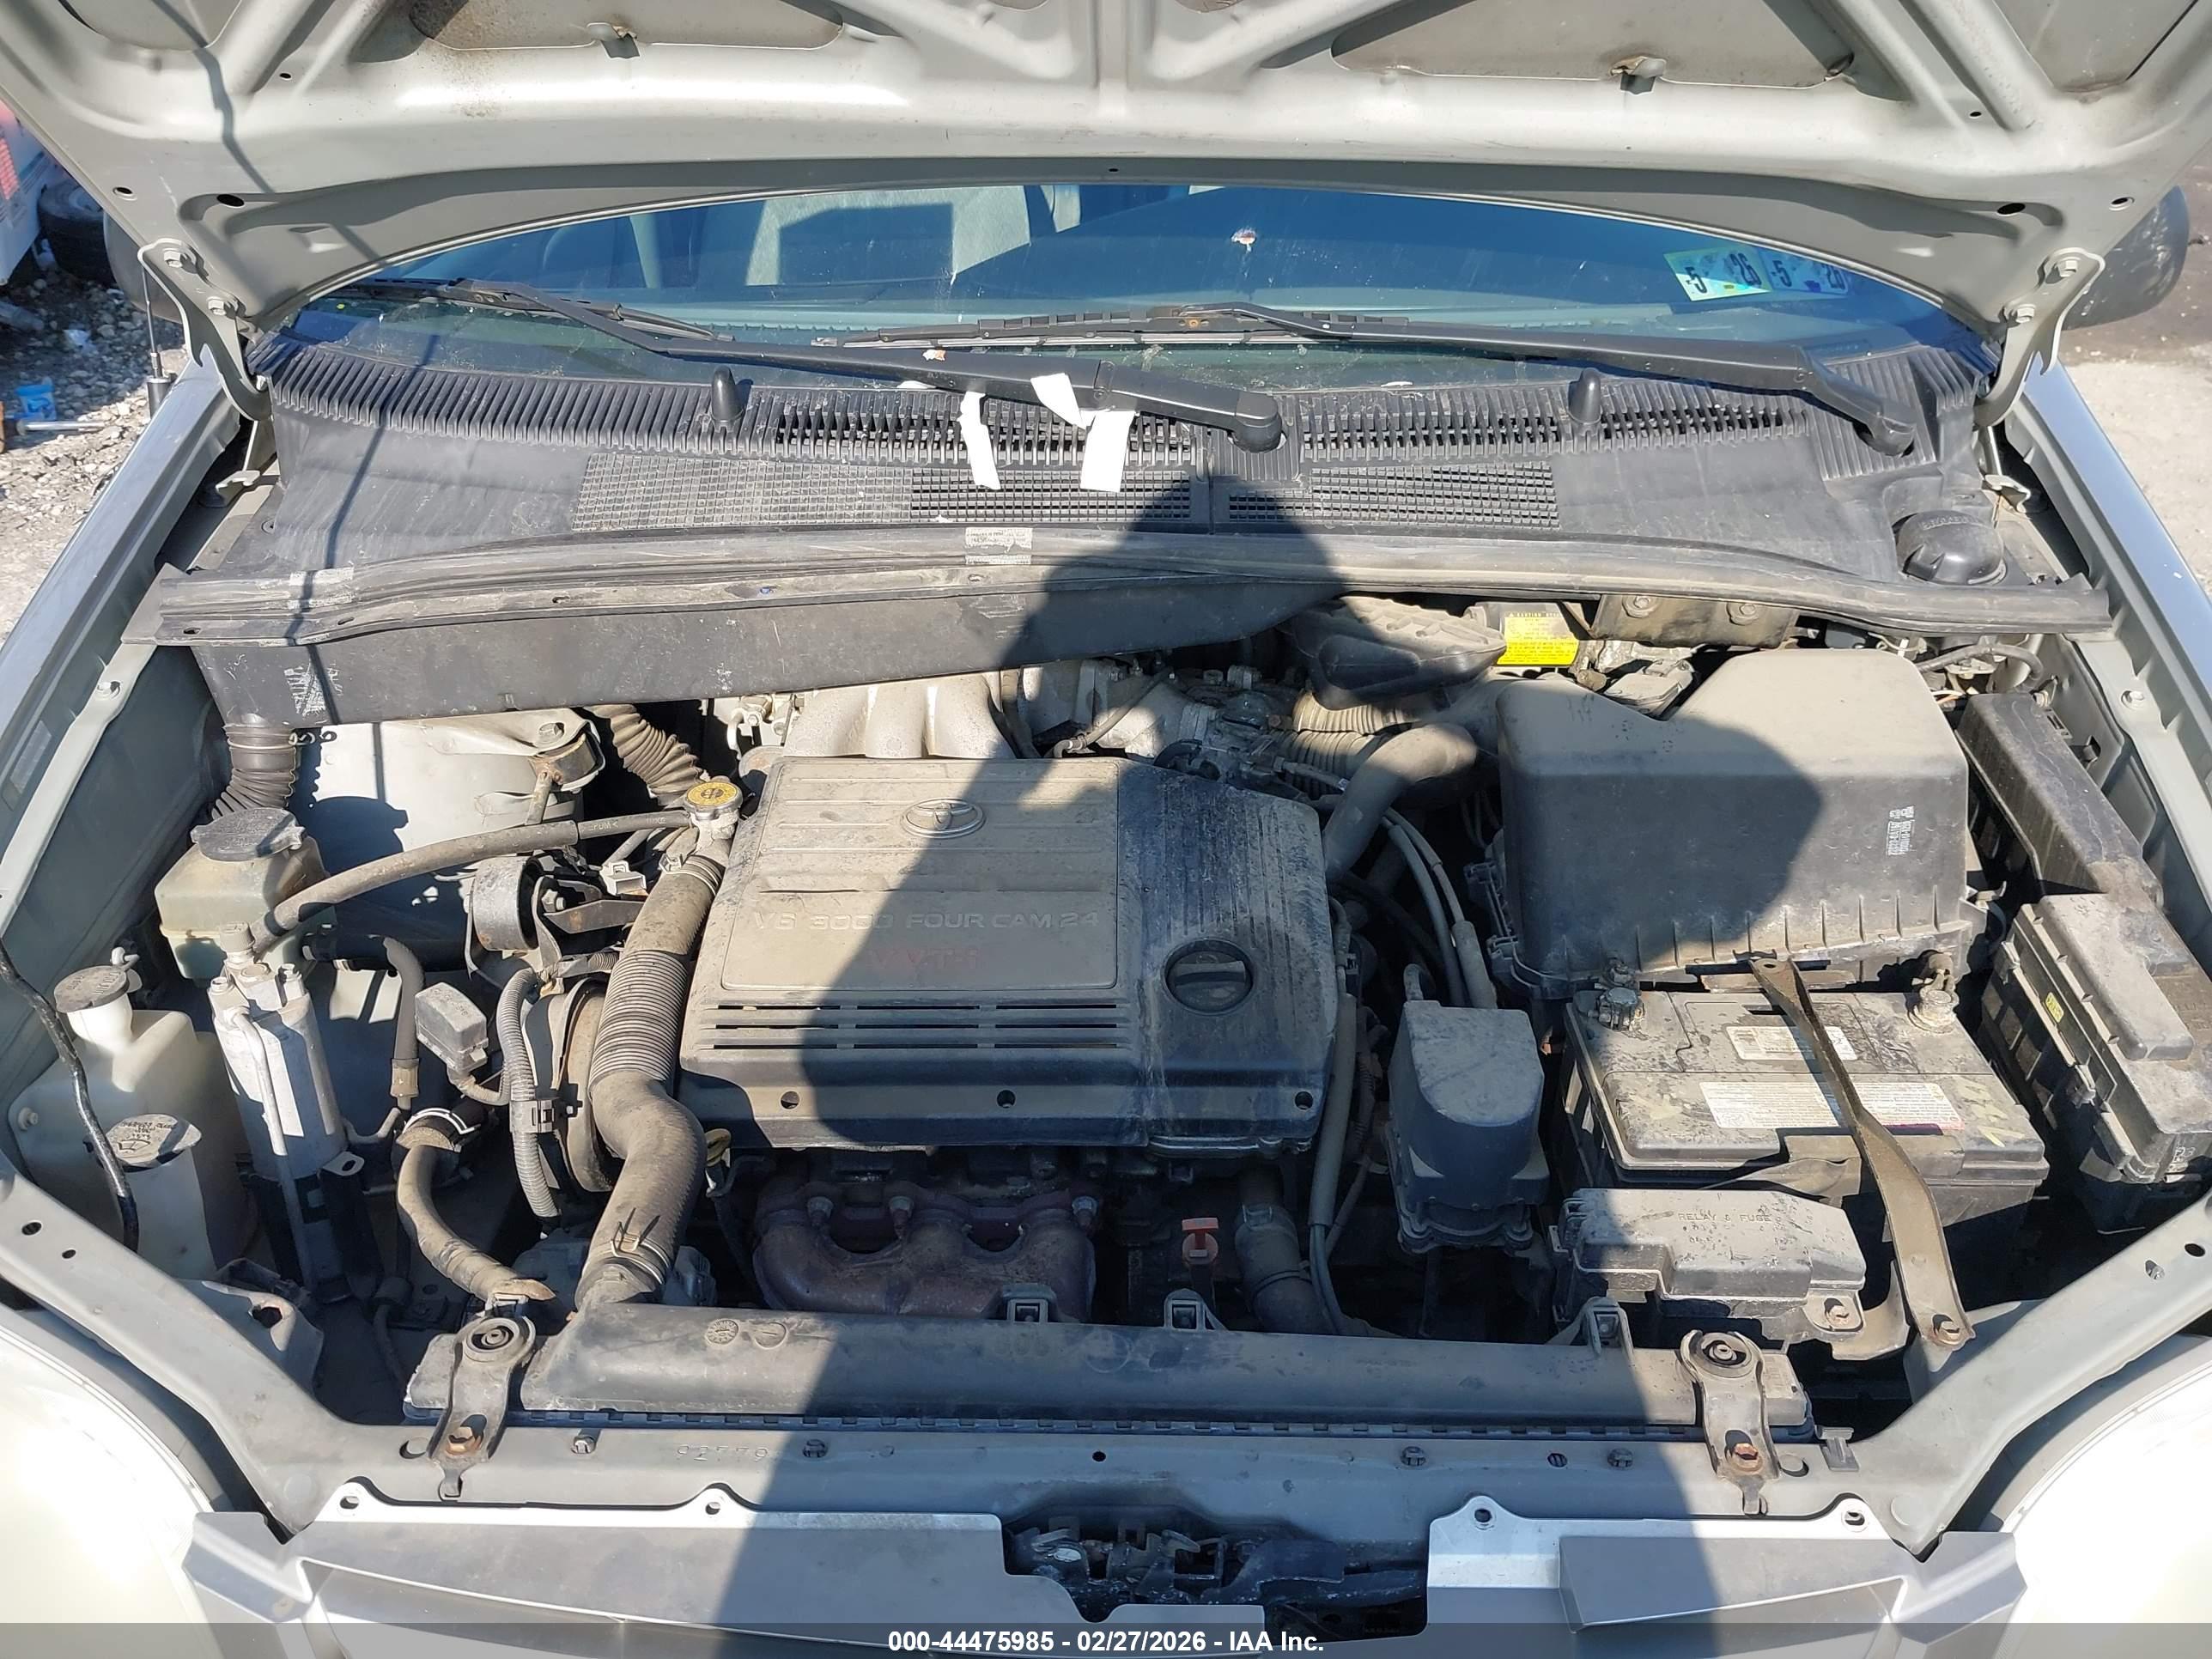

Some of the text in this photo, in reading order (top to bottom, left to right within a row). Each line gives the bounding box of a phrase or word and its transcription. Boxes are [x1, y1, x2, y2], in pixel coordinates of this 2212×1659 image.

[1729, 252, 1762, 286] 26
[753, 911, 1100, 930] V6 3000 FOUR CAM 24
[1677, 1212, 1717, 1222] RELAY
